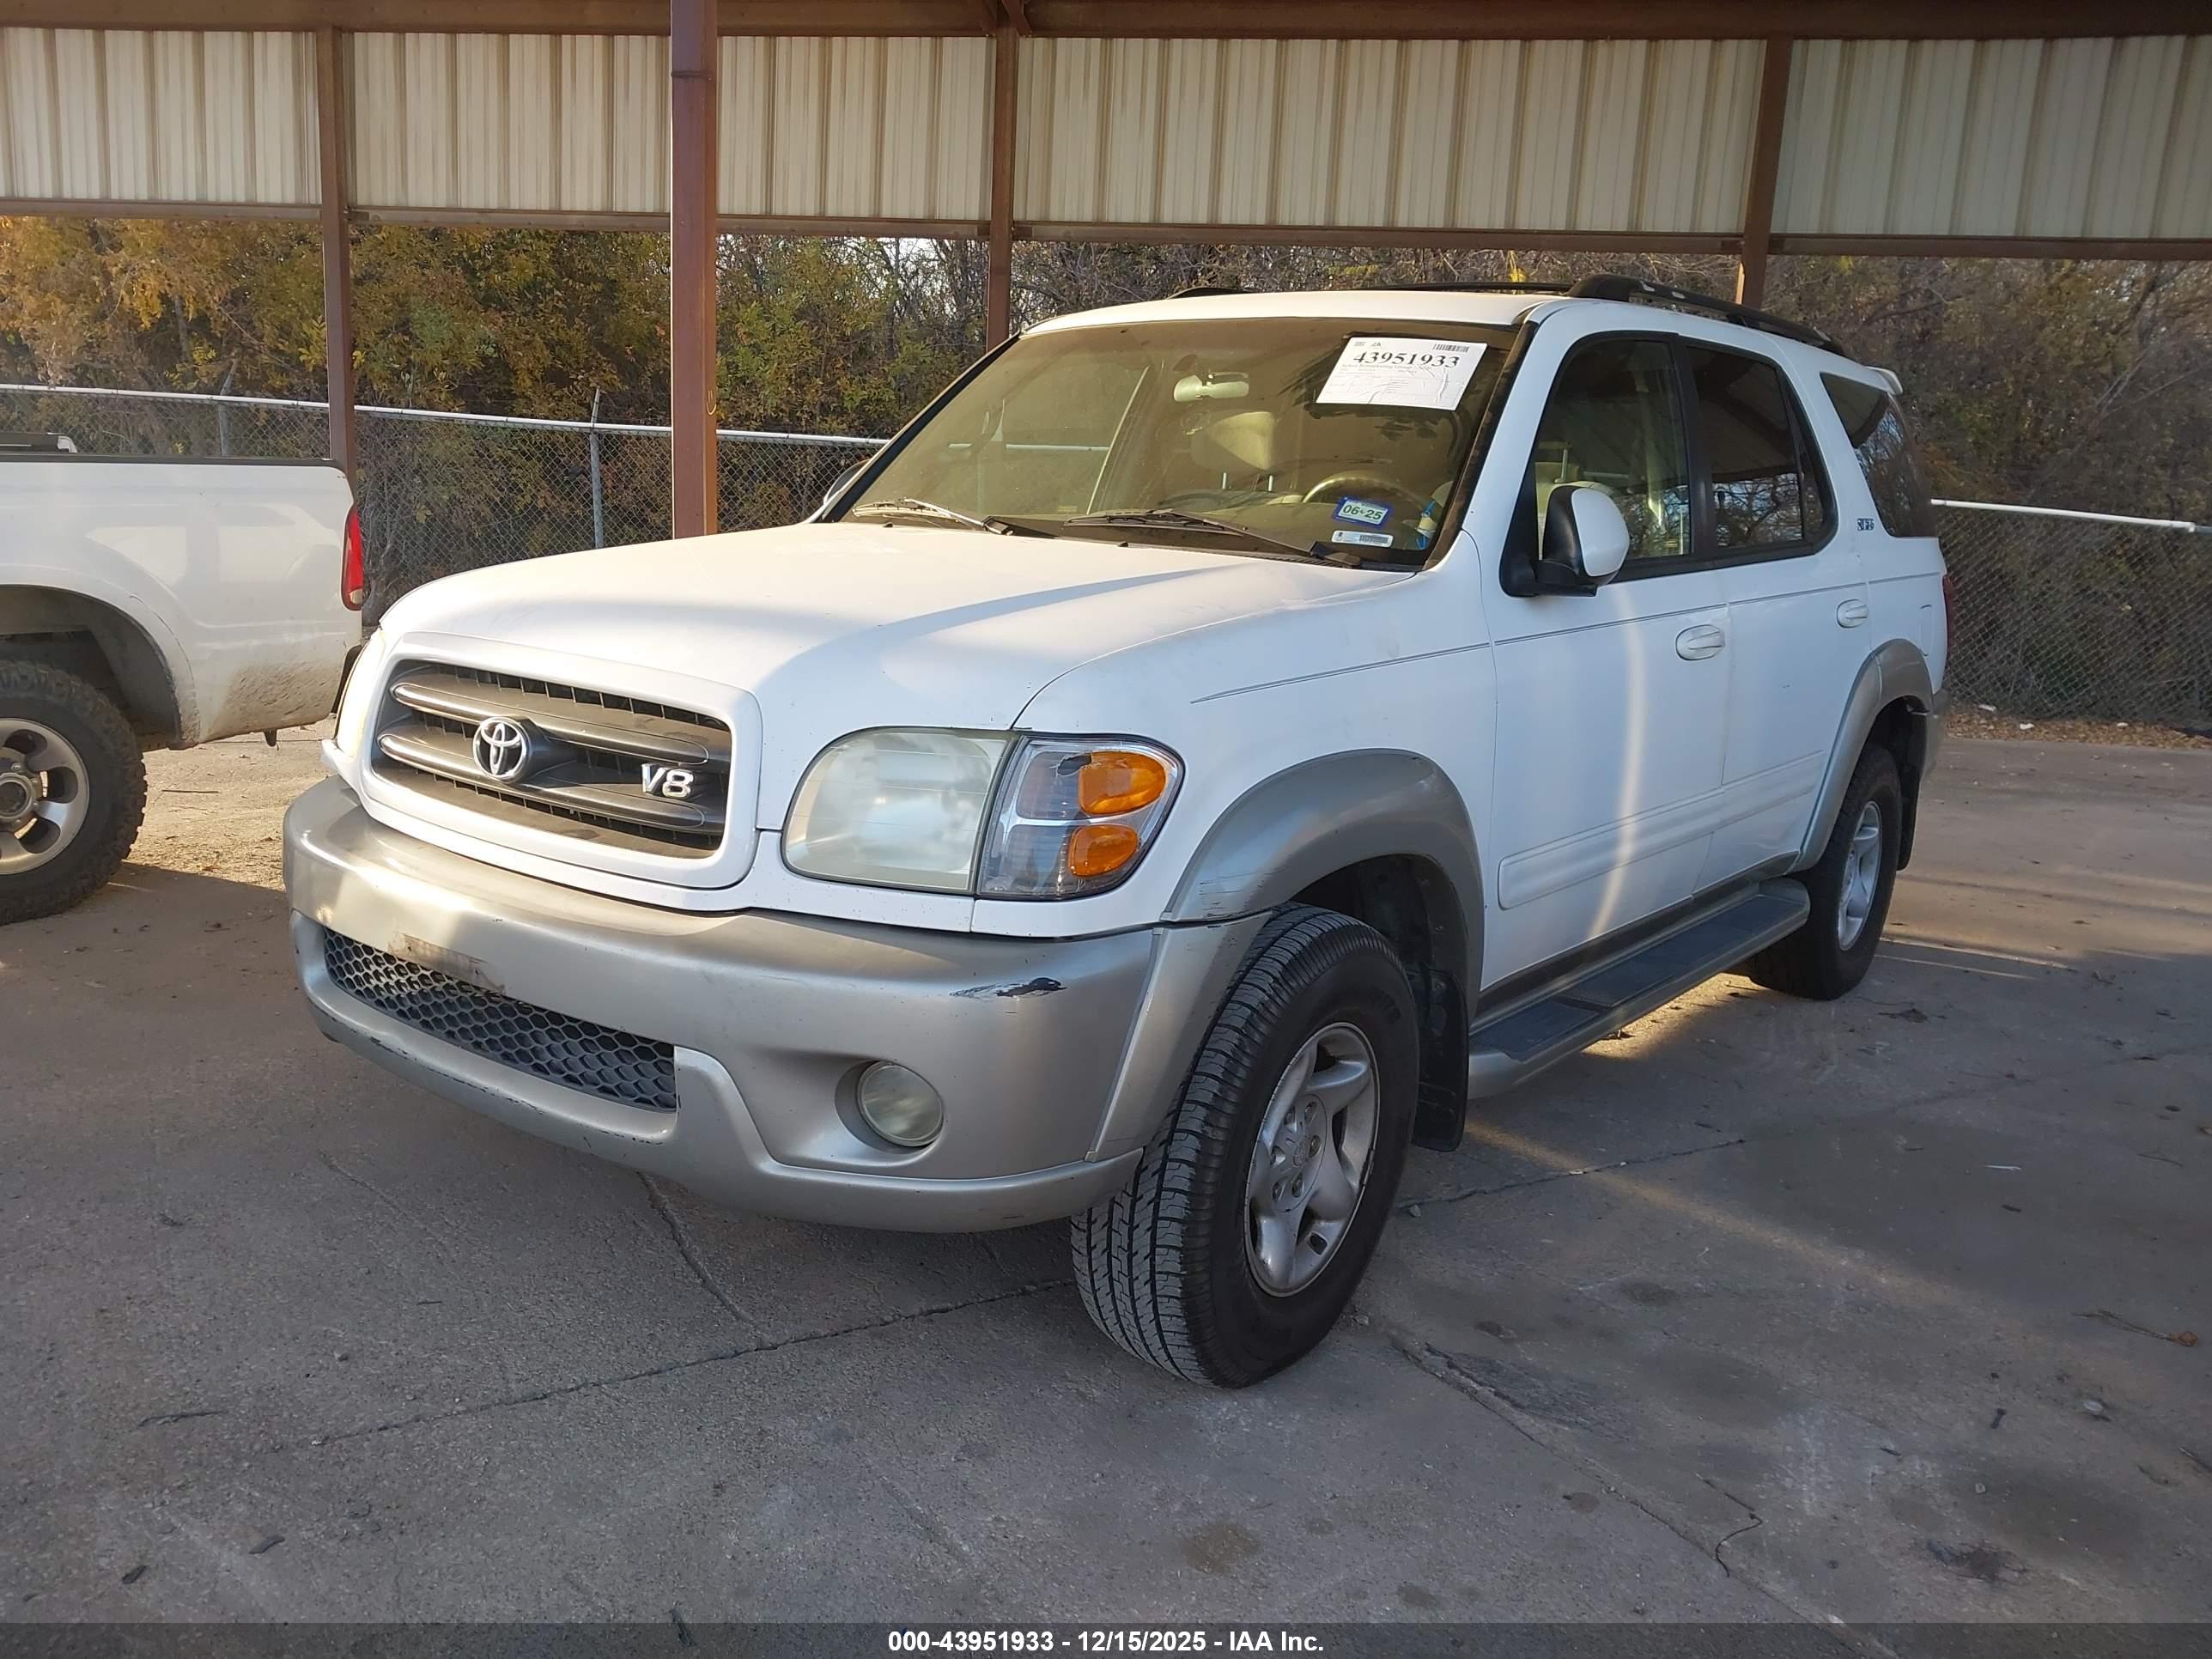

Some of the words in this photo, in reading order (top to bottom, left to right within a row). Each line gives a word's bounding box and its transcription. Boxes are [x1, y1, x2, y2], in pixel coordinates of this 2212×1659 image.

[1353, 352, 1460, 368] 43951933
[1342, 504, 1361, 515] 06
[1364, 509, 1383, 520] 25
[641, 763, 694, 798] V8
